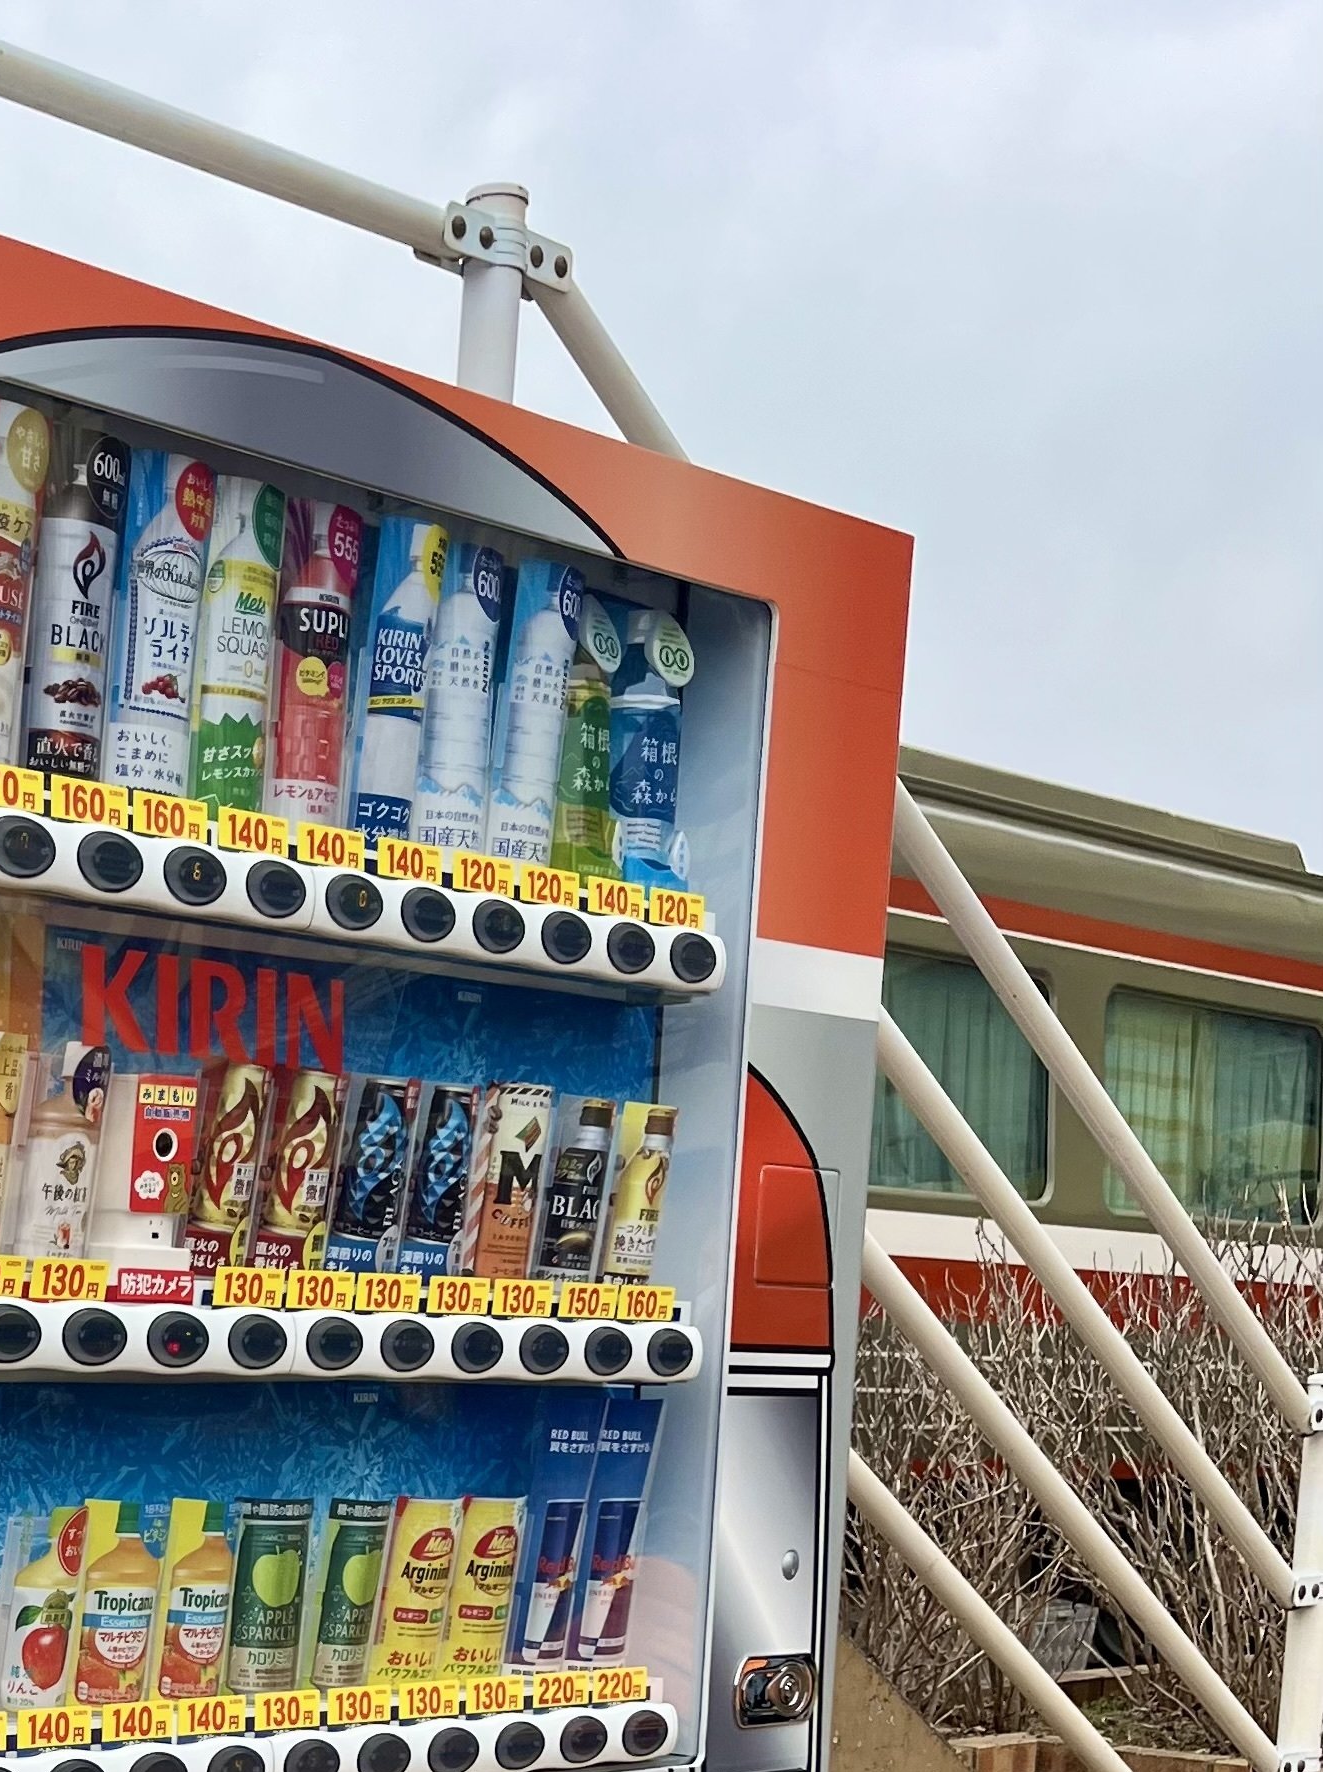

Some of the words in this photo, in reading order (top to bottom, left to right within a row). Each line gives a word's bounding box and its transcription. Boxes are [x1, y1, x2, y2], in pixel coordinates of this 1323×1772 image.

[333, 534, 359, 566] 555
[72, 600, 100, 620] FIRE
[51, 624, 106, 656] BLACK
[217, 635, 269, 662] SQUAS
[377, 627, 424, 651] KIRIN
[375, 646, 424, 671] LOVES
[580, 722, 611, 753] 箱根
[641, 736, 678, 766] 箱根
[117, 746, 168, 764] こまめに
[61, 783, 122, 826] 160円
[144, 798, 200, 840] 160円
[229, 813, 283, 856] 140円
[307, 828, 359, 870] 140円
[387, 844, 436, 881] 140円
[461, 857, 508, 896] 120円
[528, 870, 574, 908] 120円
[597, 882, 640, 918] 140円
[657, 893, 699, 929] 120円
[81, 943, 345, 1080] KIRIN
[141, 1086, 195, 1104] みまもり
[493, 1150, 543, 1207] M
[42, 1263, 100, 1298] 130円
[120, 1272, 192, 1299] 防犯カメラ
[224, 1273, 277, 1304] 130円
[297, 1276, 347, 1308] 130円
[365, 1279, 414, 1310] 130円
[436, 1281, 483, 1313] 130円
[501, 1285, 547, 1316] 130円
[568, 1287, 611, 1317] 150円
[627, 1290, 668, 1320] 160円
[551, 1428, 570, 1441] RED
[571, 1429, 590, 1442] BULL
[601, 1428, 621, 1441] RED
[622, 1429, 642, 1442] BULL
[94, 1590, 154, 1616] Tropicana
[100, 1615, 148, 1629] Essentials
[407, 1685, 453, 1716] 130円
[474, 1681, 518, 1713] 130円
[538, 1677, 584, 1705] 220円
[597, 1672, 641, 1700] 220円
[187, 1701, 240, 1732] 140円
[263, 1696, 314, 1727] 130円
[335, 1690, 385, 1720] 130円
[28, 1711, 84, 1744] 140円
[112, 1706, 166, 1738] 140円
